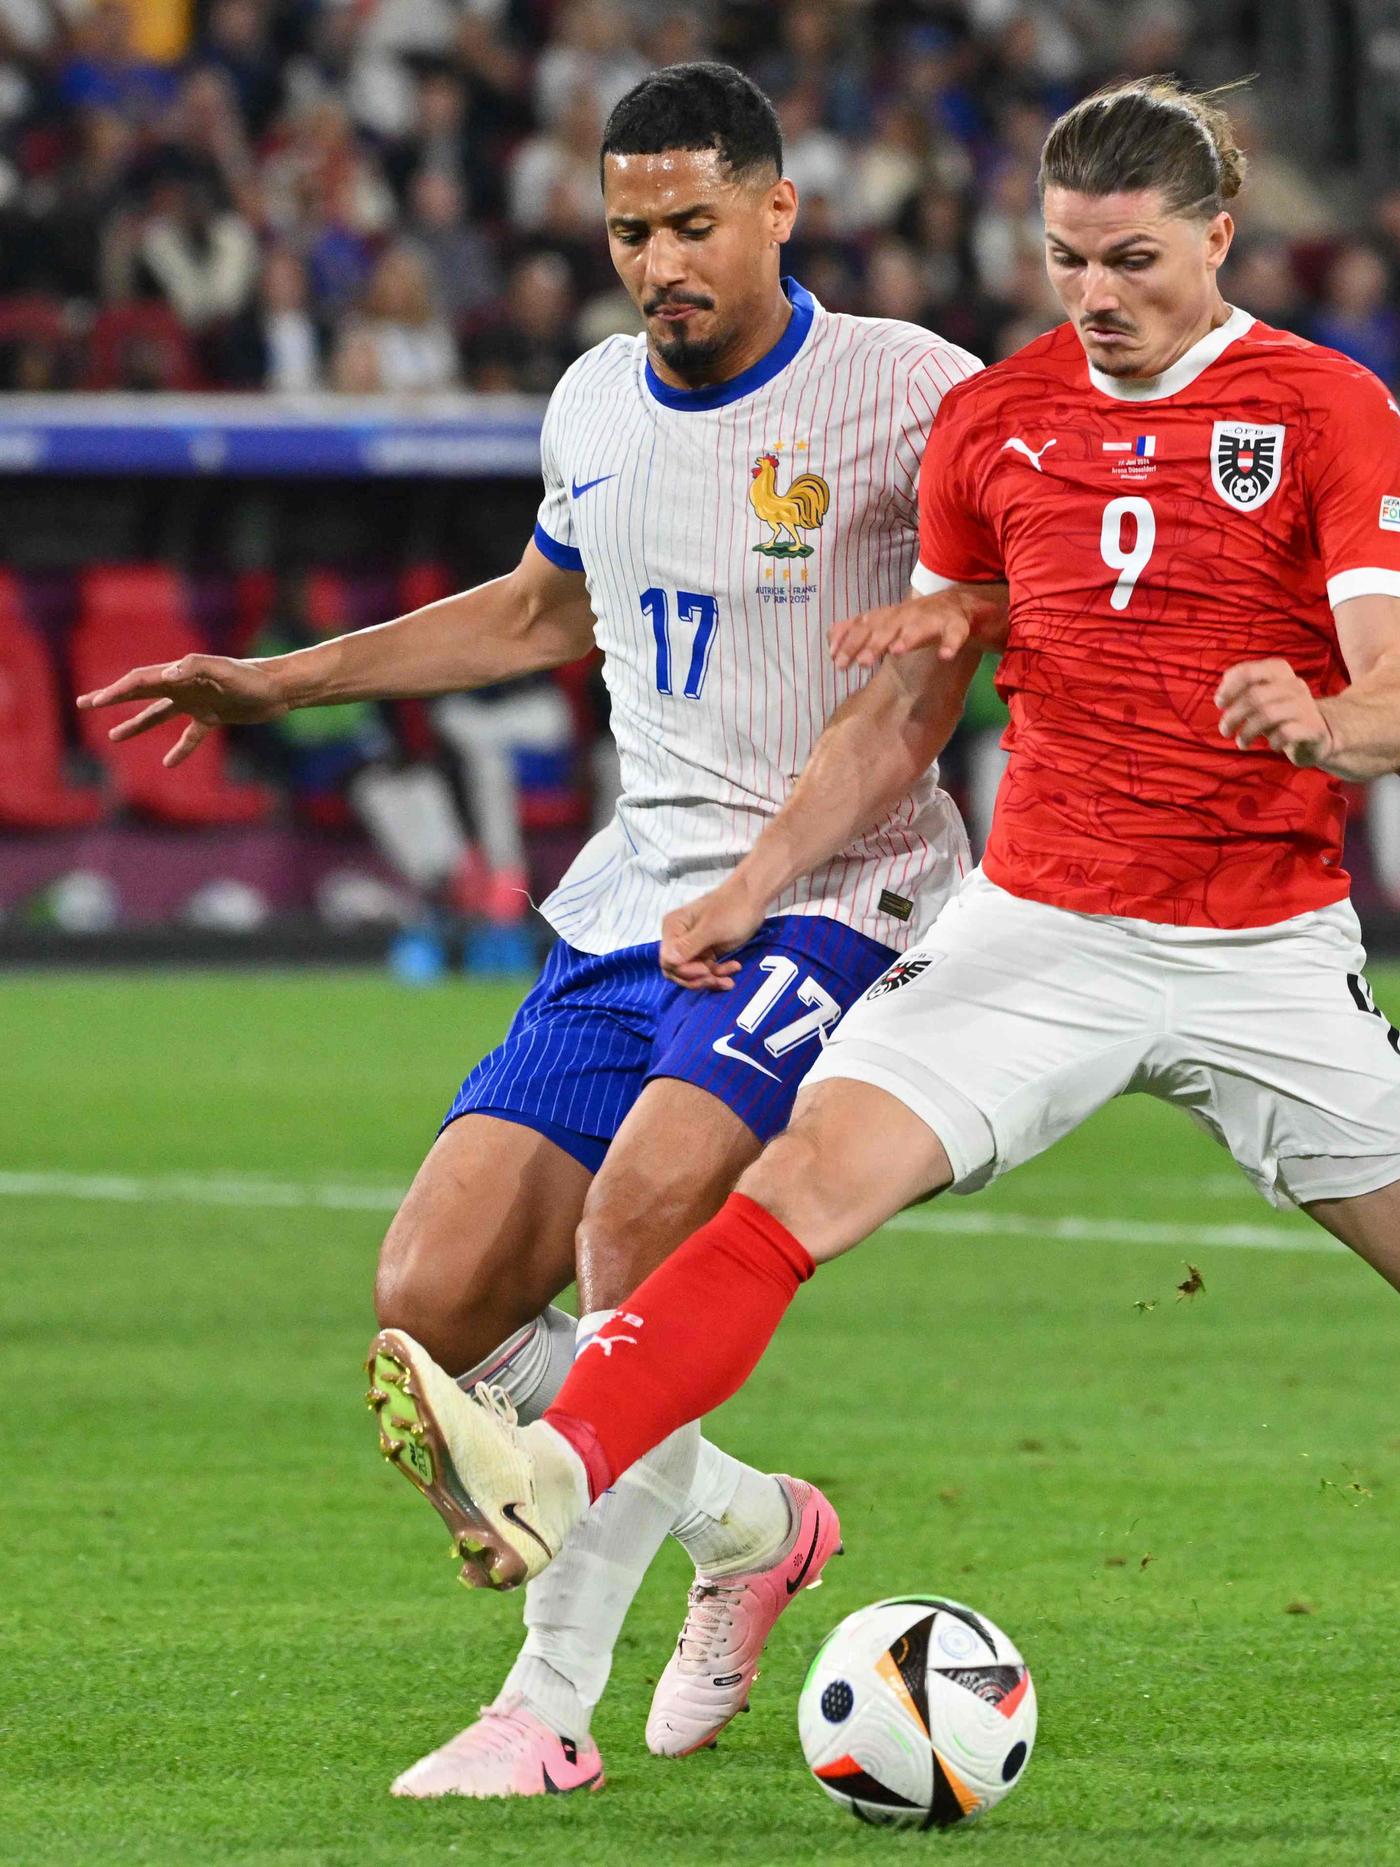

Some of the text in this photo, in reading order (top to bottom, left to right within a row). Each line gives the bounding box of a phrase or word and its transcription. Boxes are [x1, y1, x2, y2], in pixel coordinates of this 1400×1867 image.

[756, 586, 785, 595] AUTRICHE
[793, 585, 817, 594] FRANCE
[790, 595, 810, 604] 2024
[1101, 496, 1156, 611] 9
[640, 588, 718, 699] 17
[736, 955, 841, 1058] 17
